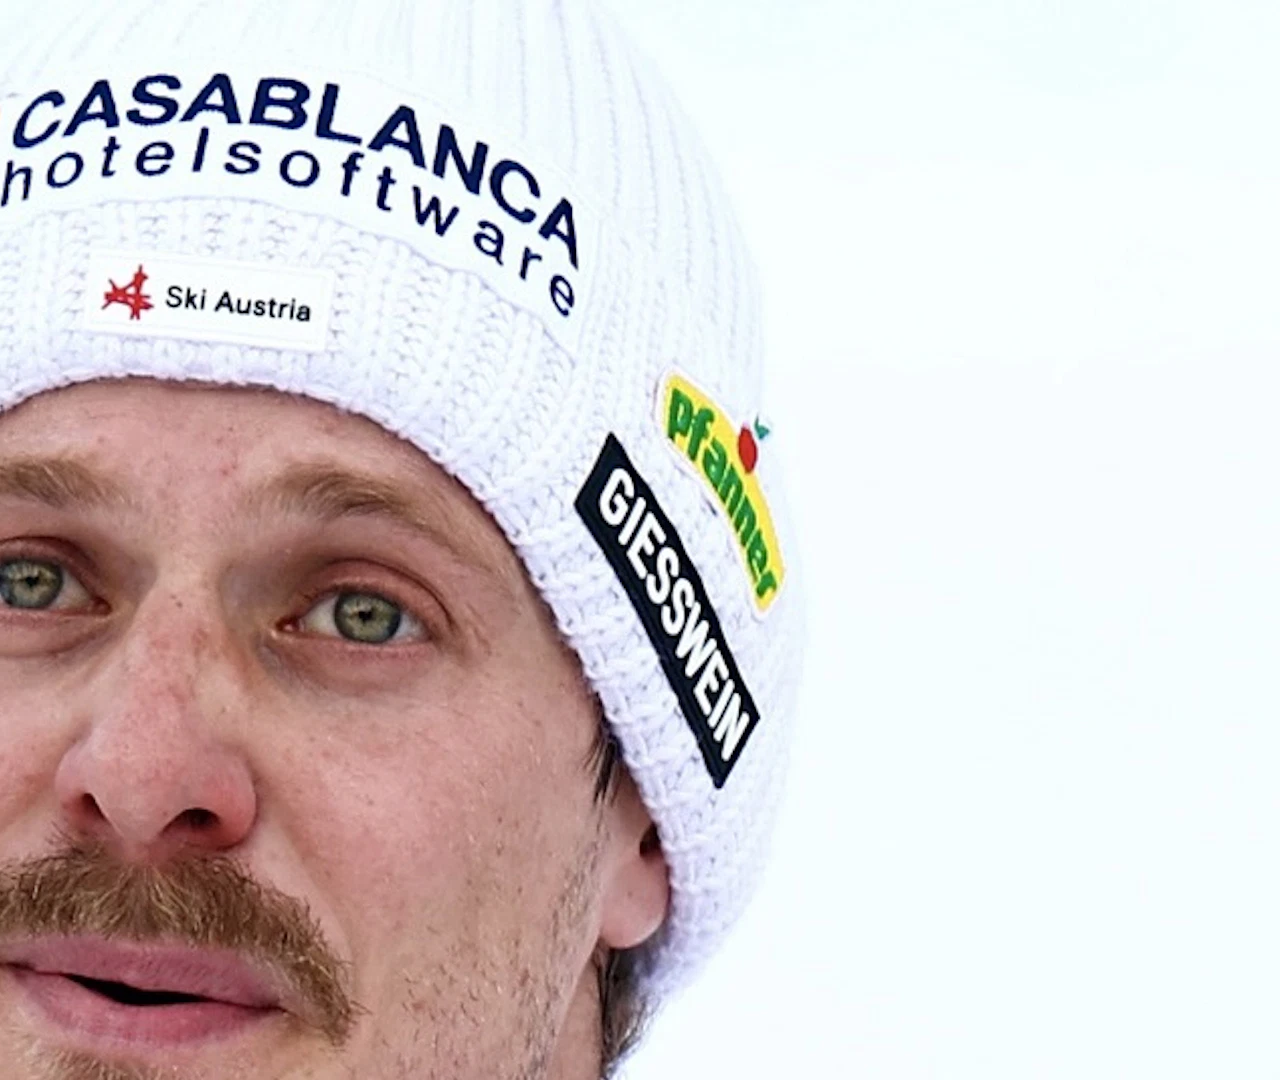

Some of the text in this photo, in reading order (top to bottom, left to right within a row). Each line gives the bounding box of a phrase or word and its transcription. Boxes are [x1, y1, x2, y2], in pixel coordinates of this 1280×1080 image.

[0, 126, 575, 318] hotelsoftware
[11, 73, 579, 270] CASABLANCA
[165, 285, 311, 322] Ski Austria
[666, 386, 778, 599] pfanner
[599, 467, 750, 762] GIESSWEIN
